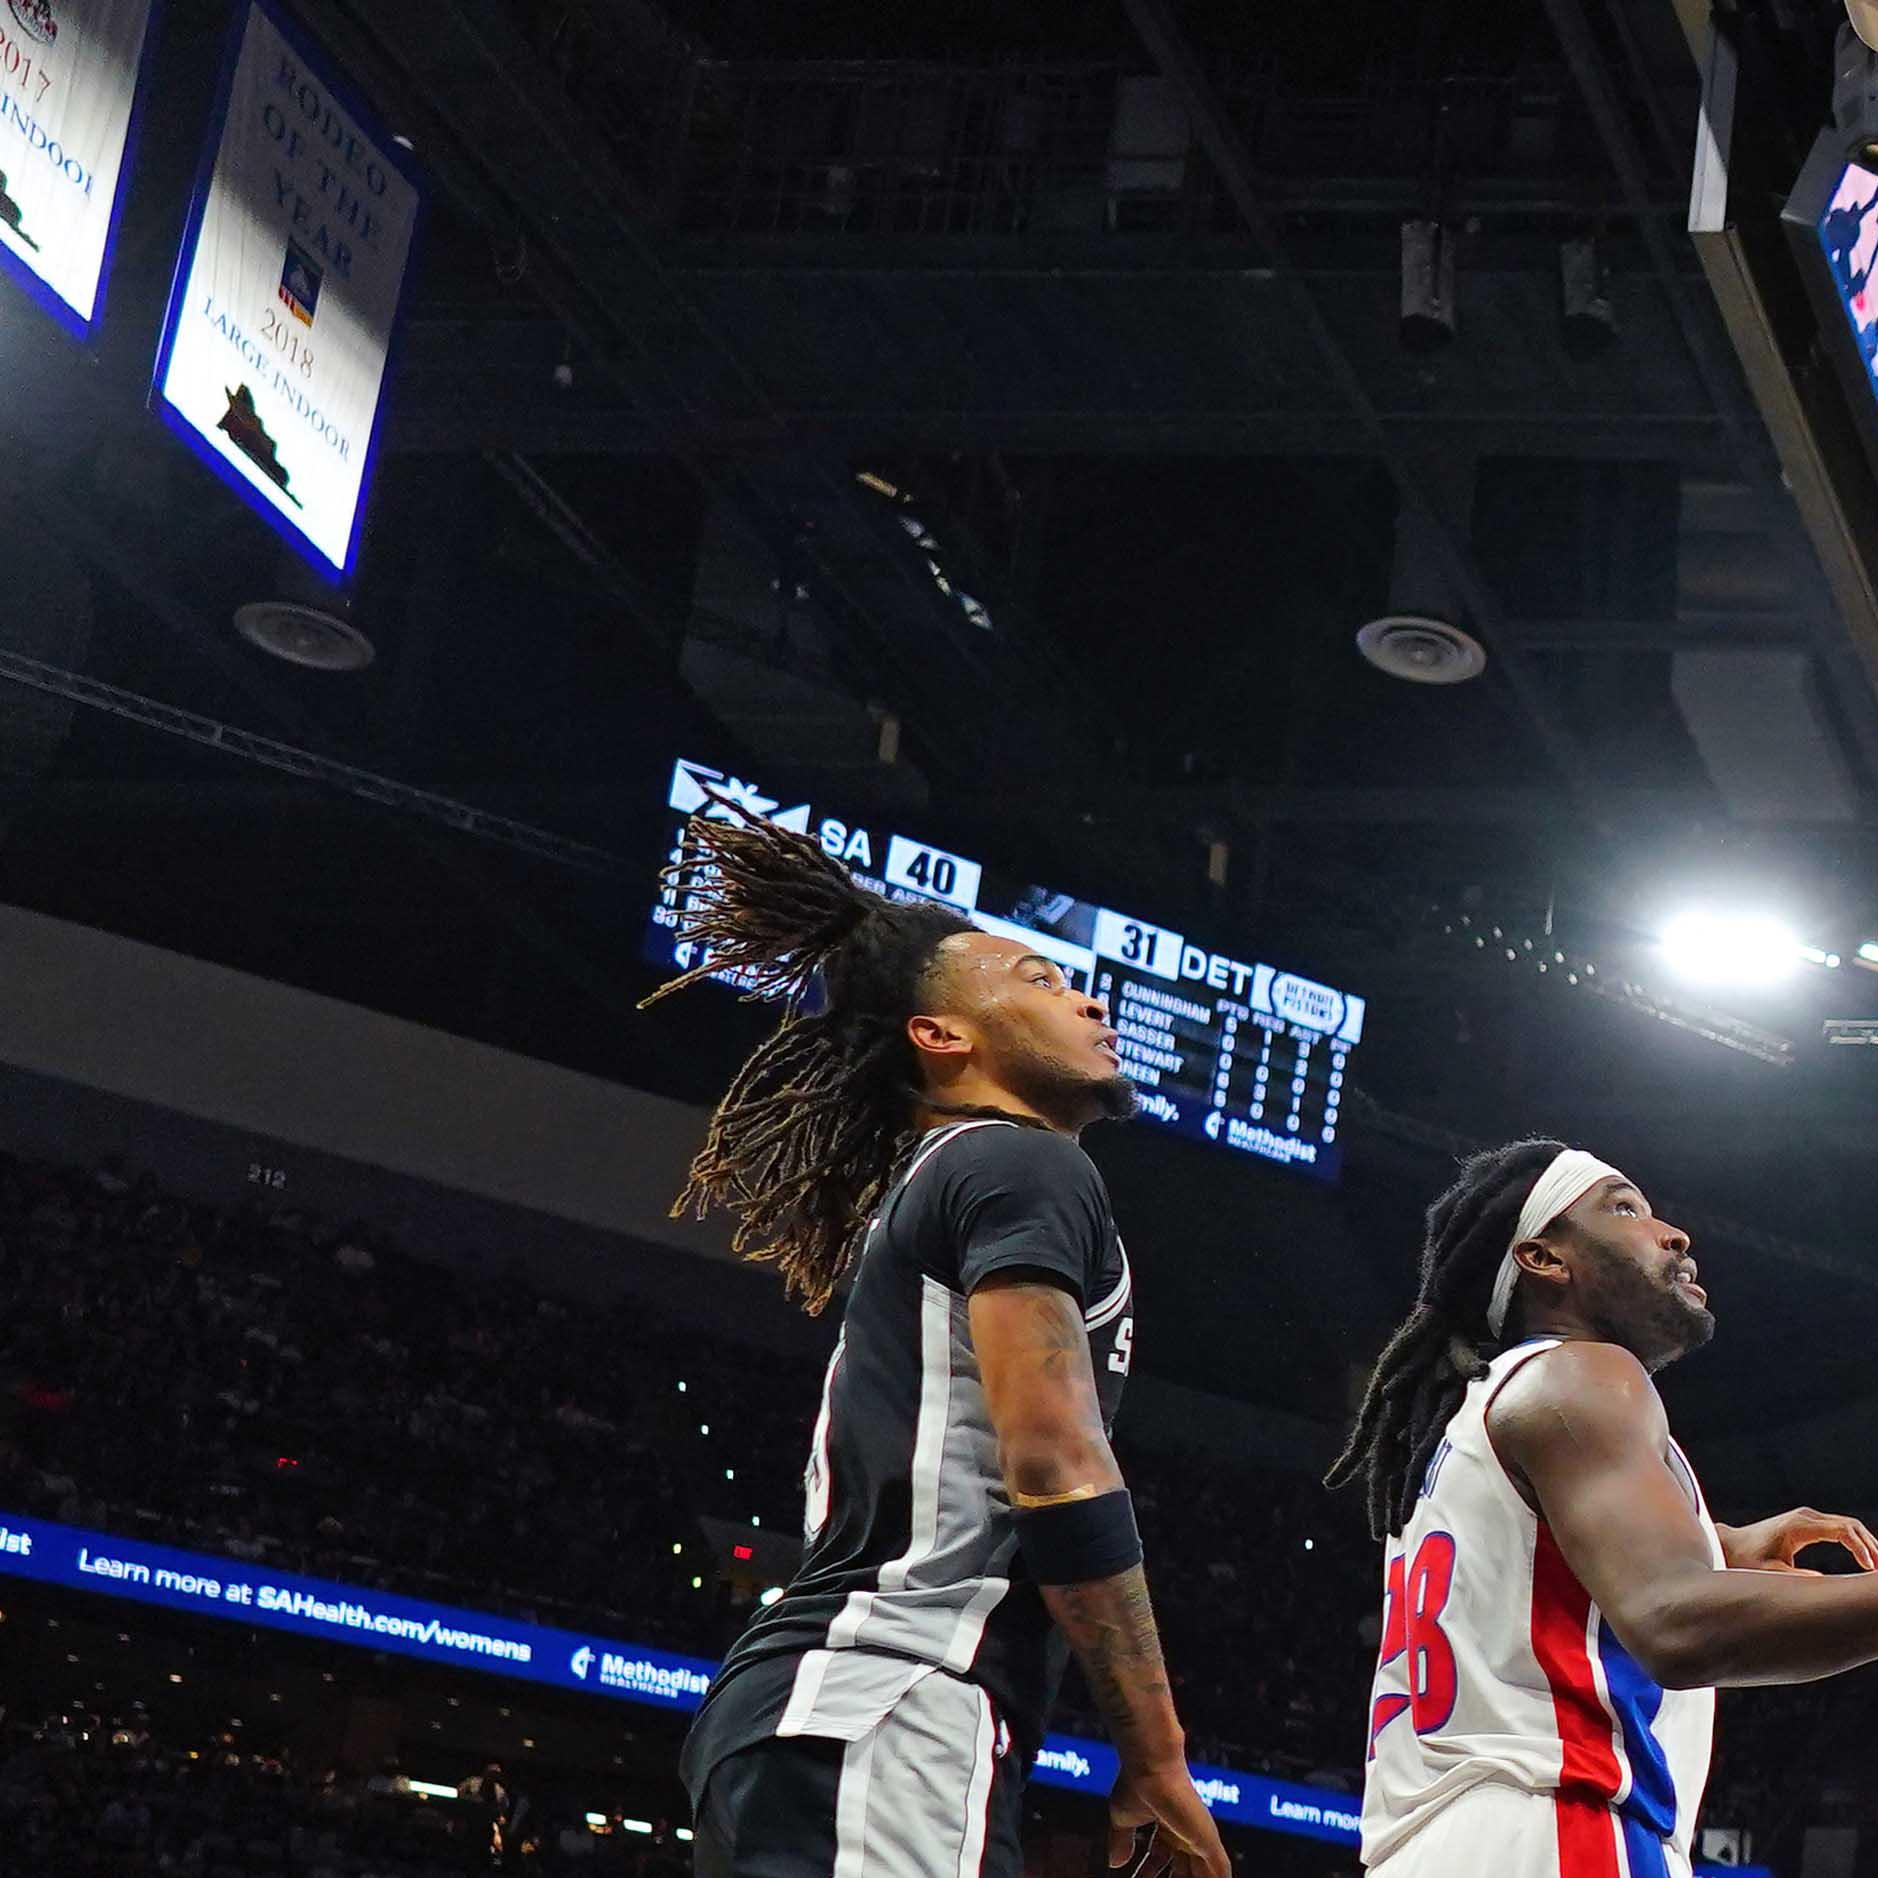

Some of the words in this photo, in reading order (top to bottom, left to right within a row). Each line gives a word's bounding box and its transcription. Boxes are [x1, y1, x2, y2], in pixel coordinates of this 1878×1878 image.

[277, 54, 388, 198] RODEO
[262, 103, 304, 160] OF
[317, 158, 381, 243] THE
[273, 166, 353, 281] YEAR
[259, 307, 315, 379] 2018
[202, 296, 268, 372] LARGE
[272, 364, 351, 463] INDOOR
[820, 818, 872, 867] SA
[906, 851, 957, 895] 40
[1122, 925, 1158, 967] 31
[1180, 945, 1253, 995] DET
[1115, 1018, 1176, 1052] SASSER
[1228, 1117, 1318, 1164] Methodist
[78, 1547, 150, 1585] Learn
[155, 1569, 222, 1599] more
[225, 1582, 254, 1606] at
[256, 1585, 533, 1664] SAHealth.com/womens
[601, 1652, 711, 1696] Methodist
[1035, 1748, 1091, 1779] amily.
[1269, 1794, 1322, 1825] Learn
[1323, 1810, 1362, 1832] mor
